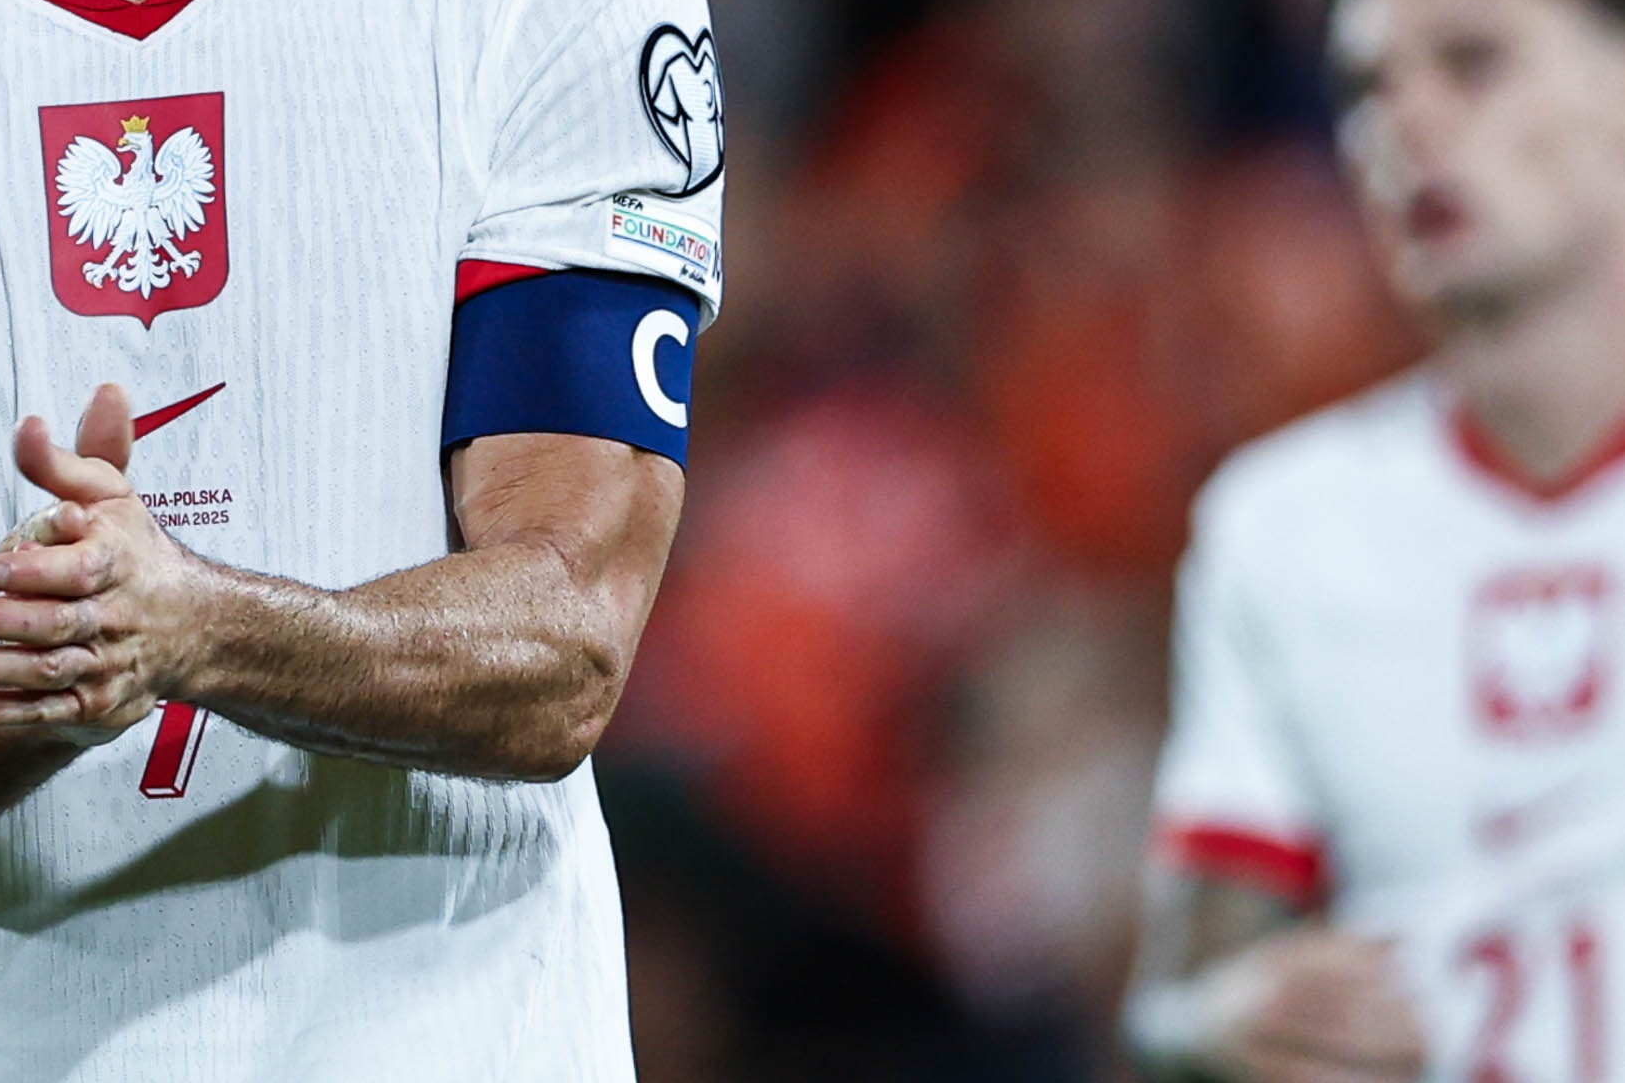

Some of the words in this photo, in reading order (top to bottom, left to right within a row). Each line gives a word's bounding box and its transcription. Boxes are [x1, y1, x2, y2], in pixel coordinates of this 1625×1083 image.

[612, 194, 644, 210] UEFA
[632, 309, 689, 429] C
[138, 488, 233, 508] DIA-POLSKA
[193, 510, 229, 526] 2025
